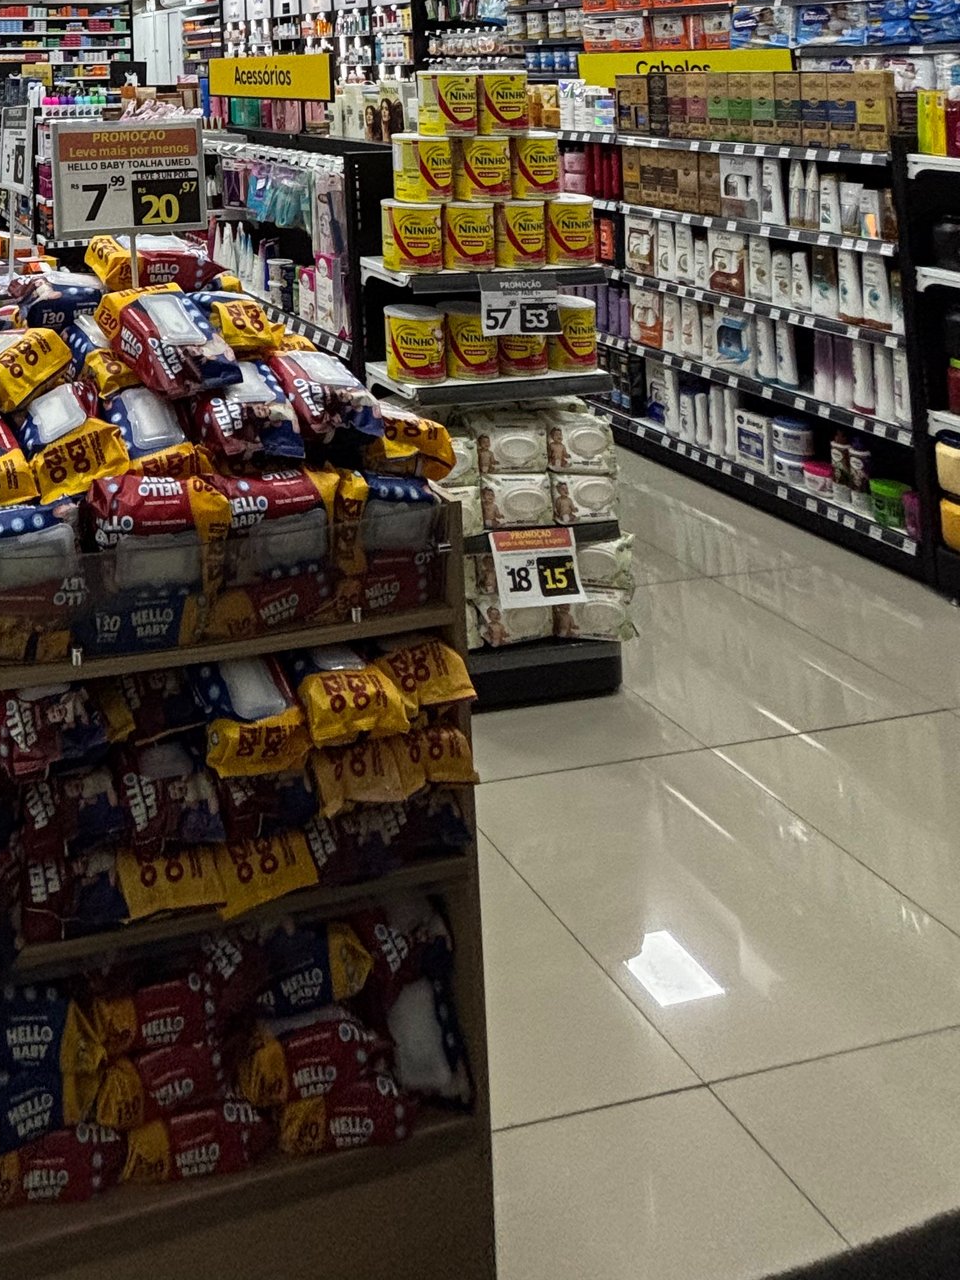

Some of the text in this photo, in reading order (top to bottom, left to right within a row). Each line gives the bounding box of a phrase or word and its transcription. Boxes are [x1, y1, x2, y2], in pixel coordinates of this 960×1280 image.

[234, 64, 292, 86] Acessórios
[496, 91, 526, 100] NINHO
[69, 144, 189, 159] Leve mais por menos
[475, 157, 506, 165] NINHO
[67, 158, 193, 171] HELLO BABY TOALHA UMED.
[82, 183, 107, 222] 7
[140, 193, 180, 225] 20
[404, 225, 437, 235] NINHO
[458, 224, 490, 234] NINHO
[147, 263, 180, 274] HELLO
[150, 273, 175, 283] BABY
[42, 312, 64, 324] 130
[98, 309, 118, 331] 130
[486, 308, 512, 330] 57
[525, 309, 549, 328] 53
[121, 326, 143, 354] HELLO
[121, 339, 141, 359] BABY
[400, 335, 435, 346] NINHO
[147, 338, 175, 380] HELLO
[293, 378, 320, 416] HELLO
[210, 397, 233, 437] HELLO
[44, 449, 67, 484] 120
[66, 439, 90, 474] 130
[138, 482, 183, 497] HELLO
[506, 567, 532, 593] 18
[543, 567, 568, 589] 15
[259, 593, 300, 620] HELLO
[131, 609, 174, 629] HELLO
[136, 624, 170, 638] BABY
[320, 673, 347, 713] 120
[346, 673, 371, 711] 130
[123, 772, 149, 832] HELLO
[280, 968, 324, 997] HELLO
[289, 985, 321, 1006] BABY
[6, 1025, 53, 1046] HELLO
[141, 1016, 185, 1039] HELLO
[12, 1043, 48, 1062] BABY
[293, 1065, 337, 1089] HELLO
[7, 1093, 54, 1126] HELLO
[16, 1110, 52, 1138] BABY
[330, 1116, 374, 1137] HELLO
[175, 1143, 220, 1168] HELLO
[23, 1170, 69, 1191] HELLO
